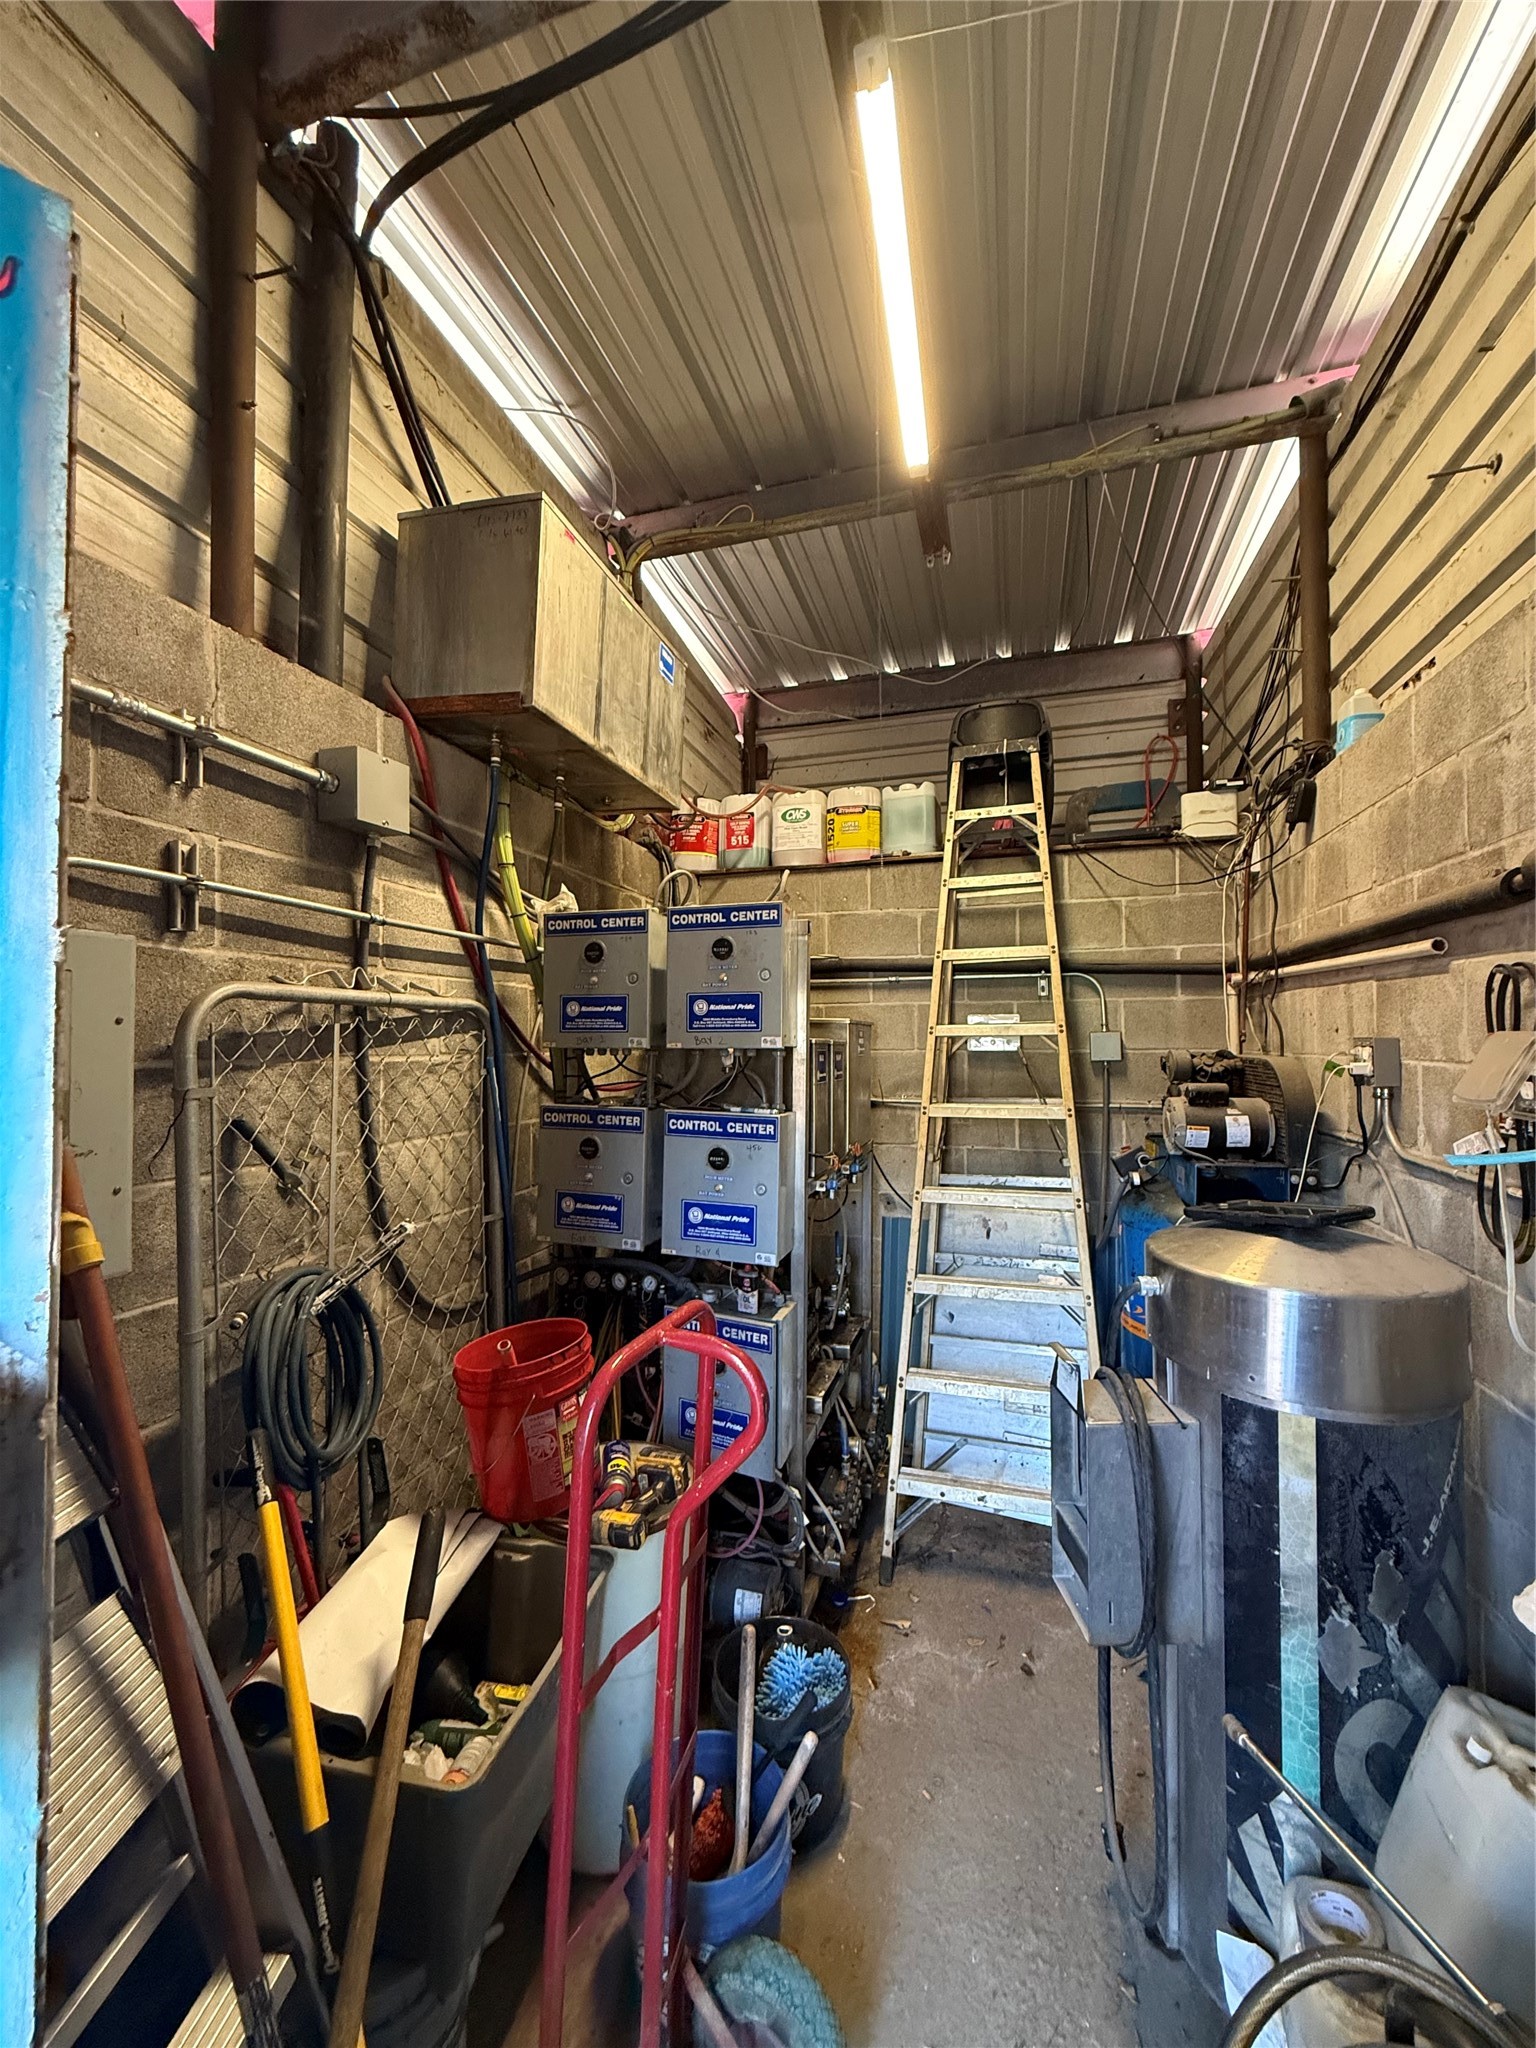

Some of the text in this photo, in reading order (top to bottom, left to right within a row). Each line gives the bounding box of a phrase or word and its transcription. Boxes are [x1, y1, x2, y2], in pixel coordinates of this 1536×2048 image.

[785, 809, 807, 820] CWS
[731, 835, 750, 846] 515
[672, 909, 778, 925] CONTROL CENTER
[548, 916, 645, 931] CONTROL CENTER
[709, 1003, 737, 1011] National
[544, 1112, 641, 1127] CONTROL CENTER
[669, 1118, 775, 1135] CONTROL CENTER
[575, 1202, 618, 1212] National Pride
[703, 1213, 750, 1224] National Pride
[722, 1326, 768, 1345] CENTER
[725, 1420, 743, 1432] Pride
